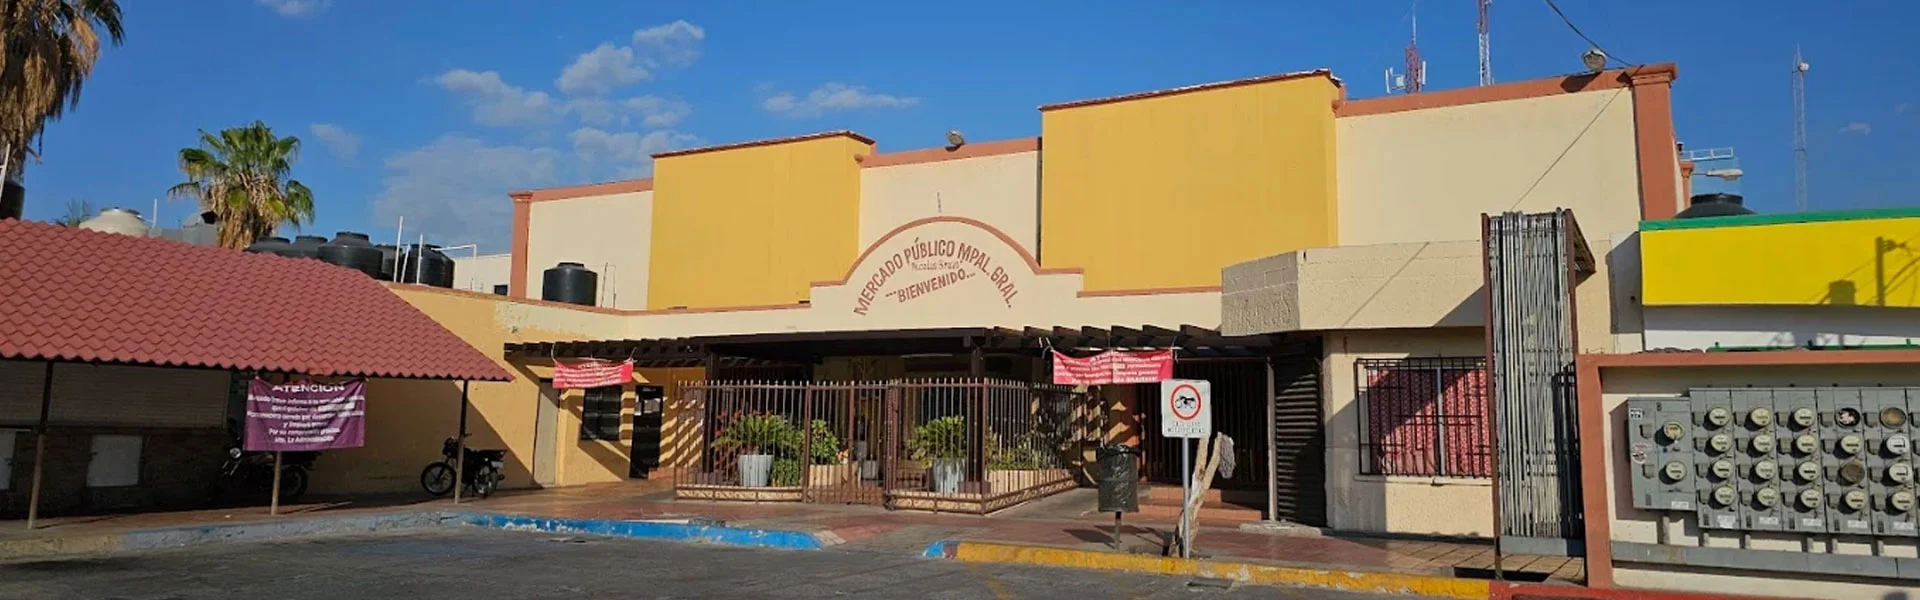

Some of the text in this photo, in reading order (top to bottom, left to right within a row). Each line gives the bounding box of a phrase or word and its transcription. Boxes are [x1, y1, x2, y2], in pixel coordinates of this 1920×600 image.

[853, 253, 904, 316] MERCADO
[904, 237, 956, 264] PÚBLICO
[957, 242, 990, 277] MPAL.
